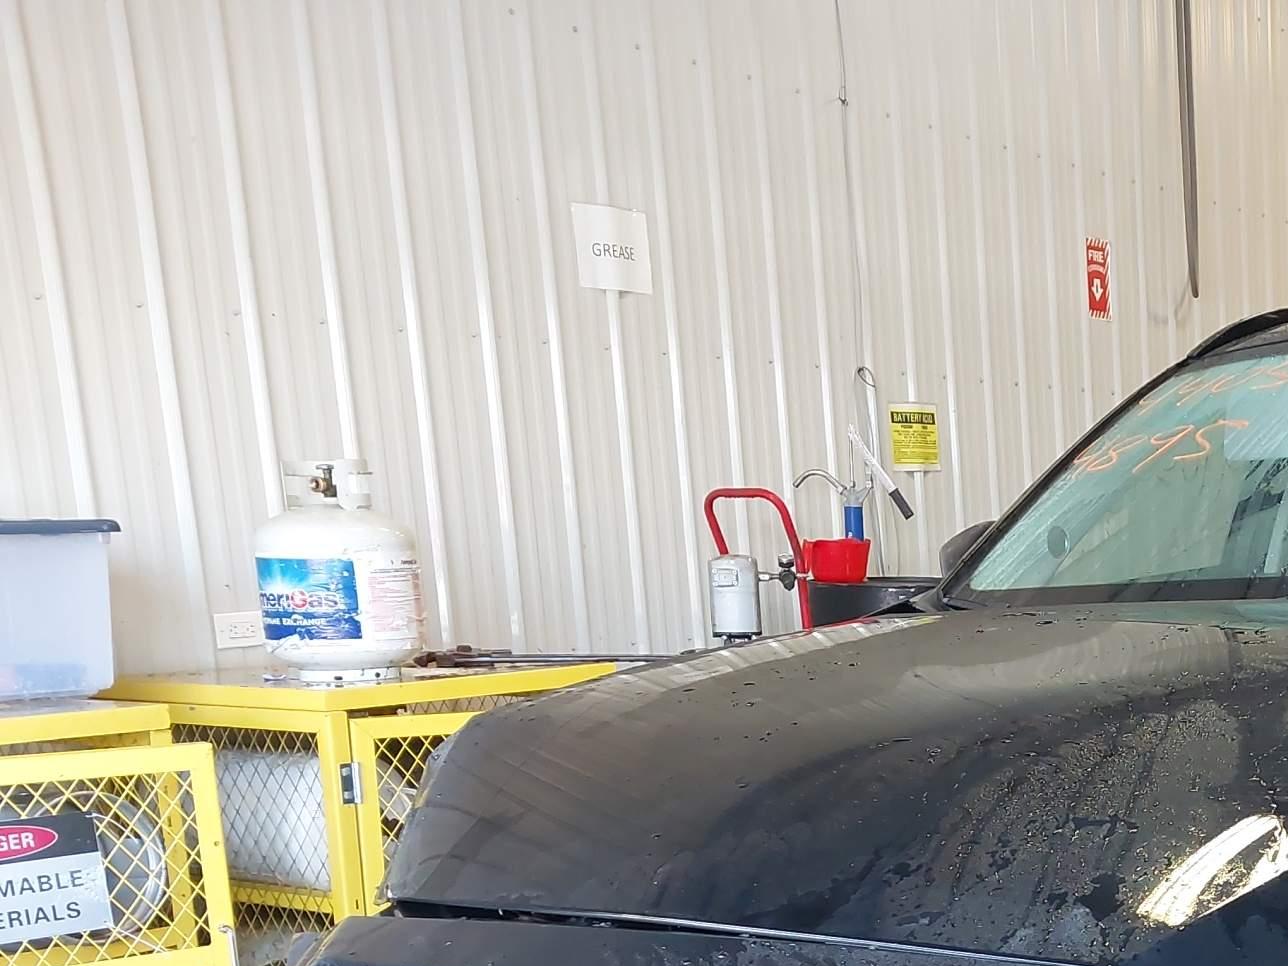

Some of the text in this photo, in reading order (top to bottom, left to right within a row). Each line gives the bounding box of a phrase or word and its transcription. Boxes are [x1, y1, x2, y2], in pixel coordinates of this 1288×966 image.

[592, 242, 636, 261] GREASE
[1088, 249, 1104, 263] FIRE
[893, 413, 921, 423] BATTERY
